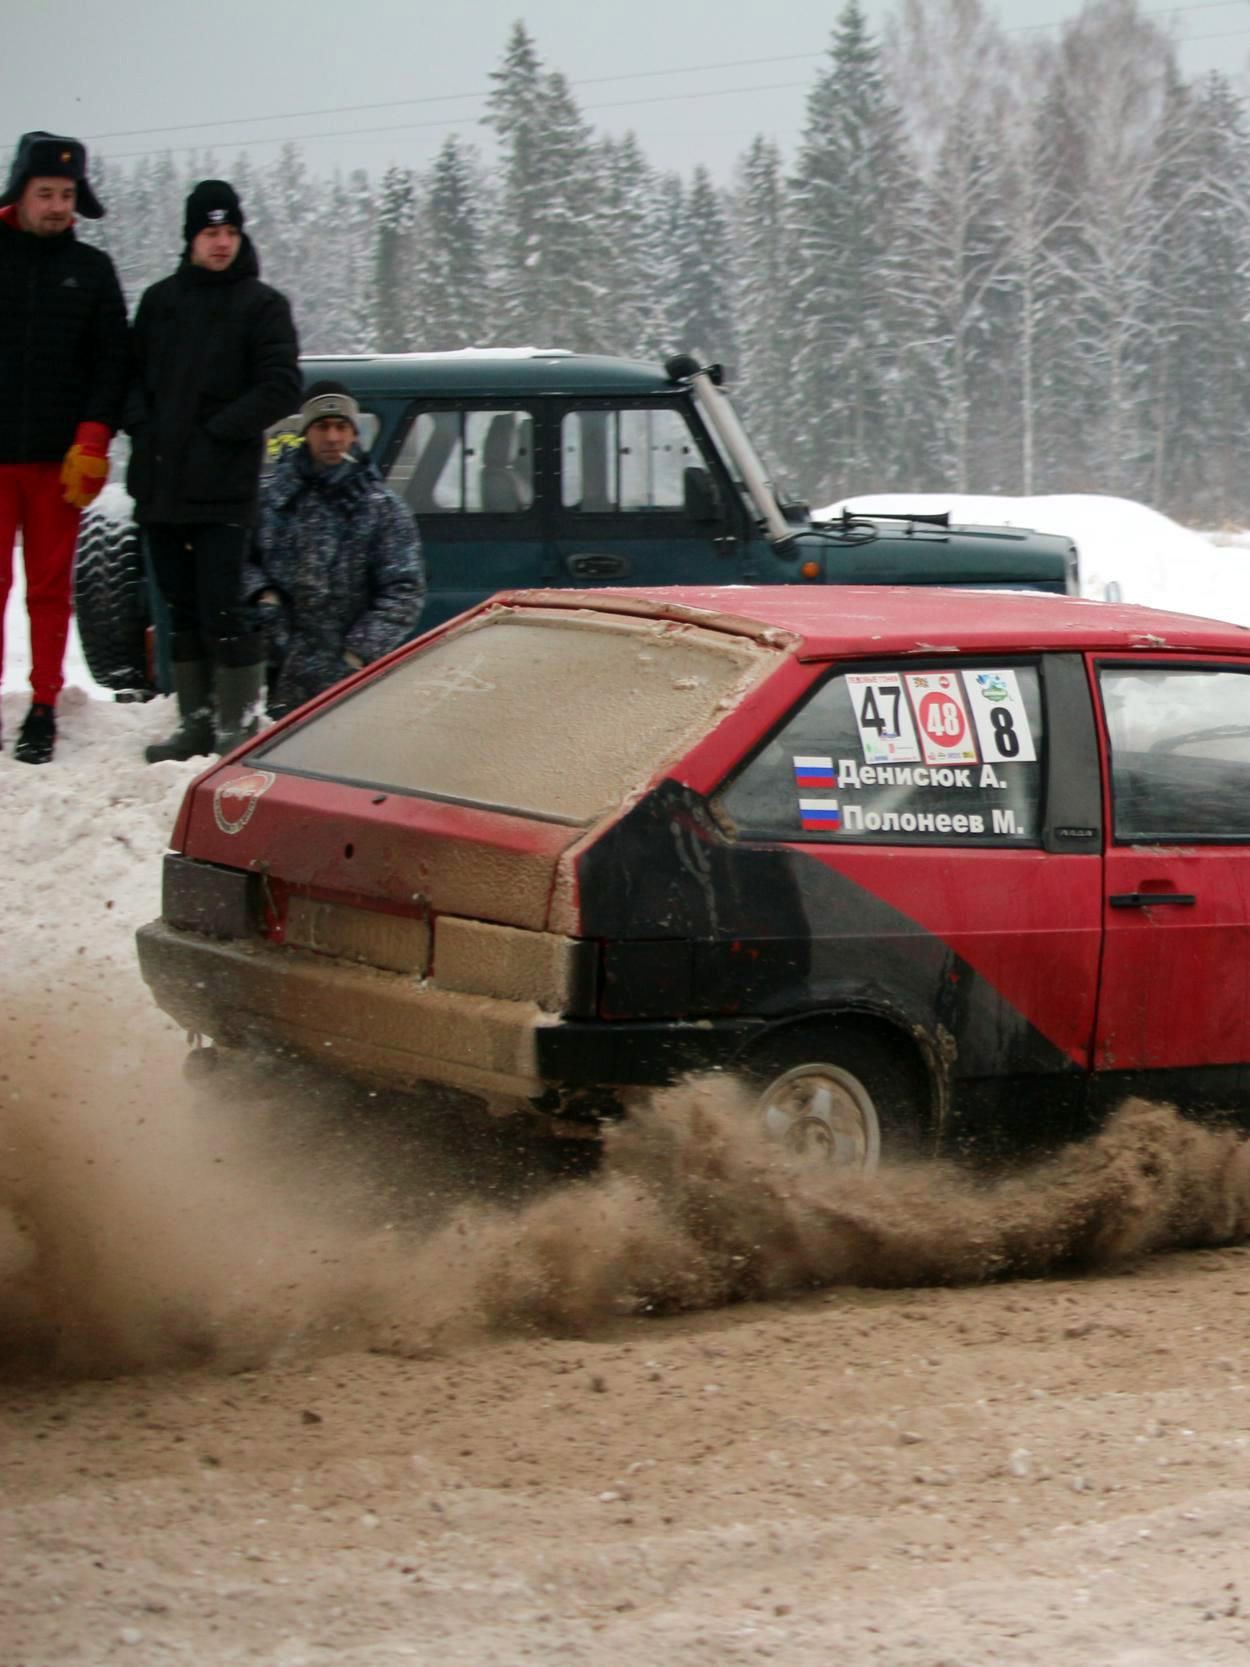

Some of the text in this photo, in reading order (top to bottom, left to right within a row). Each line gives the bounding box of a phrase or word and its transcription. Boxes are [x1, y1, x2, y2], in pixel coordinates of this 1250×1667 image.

[861, 686, 901, 737] 47
[927, 702, 961, 737] 48
[990, 707, 1020, 758] 8
[837, 759, 1008, 789] Денисюк А.
[842, 805, 1025, 835] Полонеев М.
